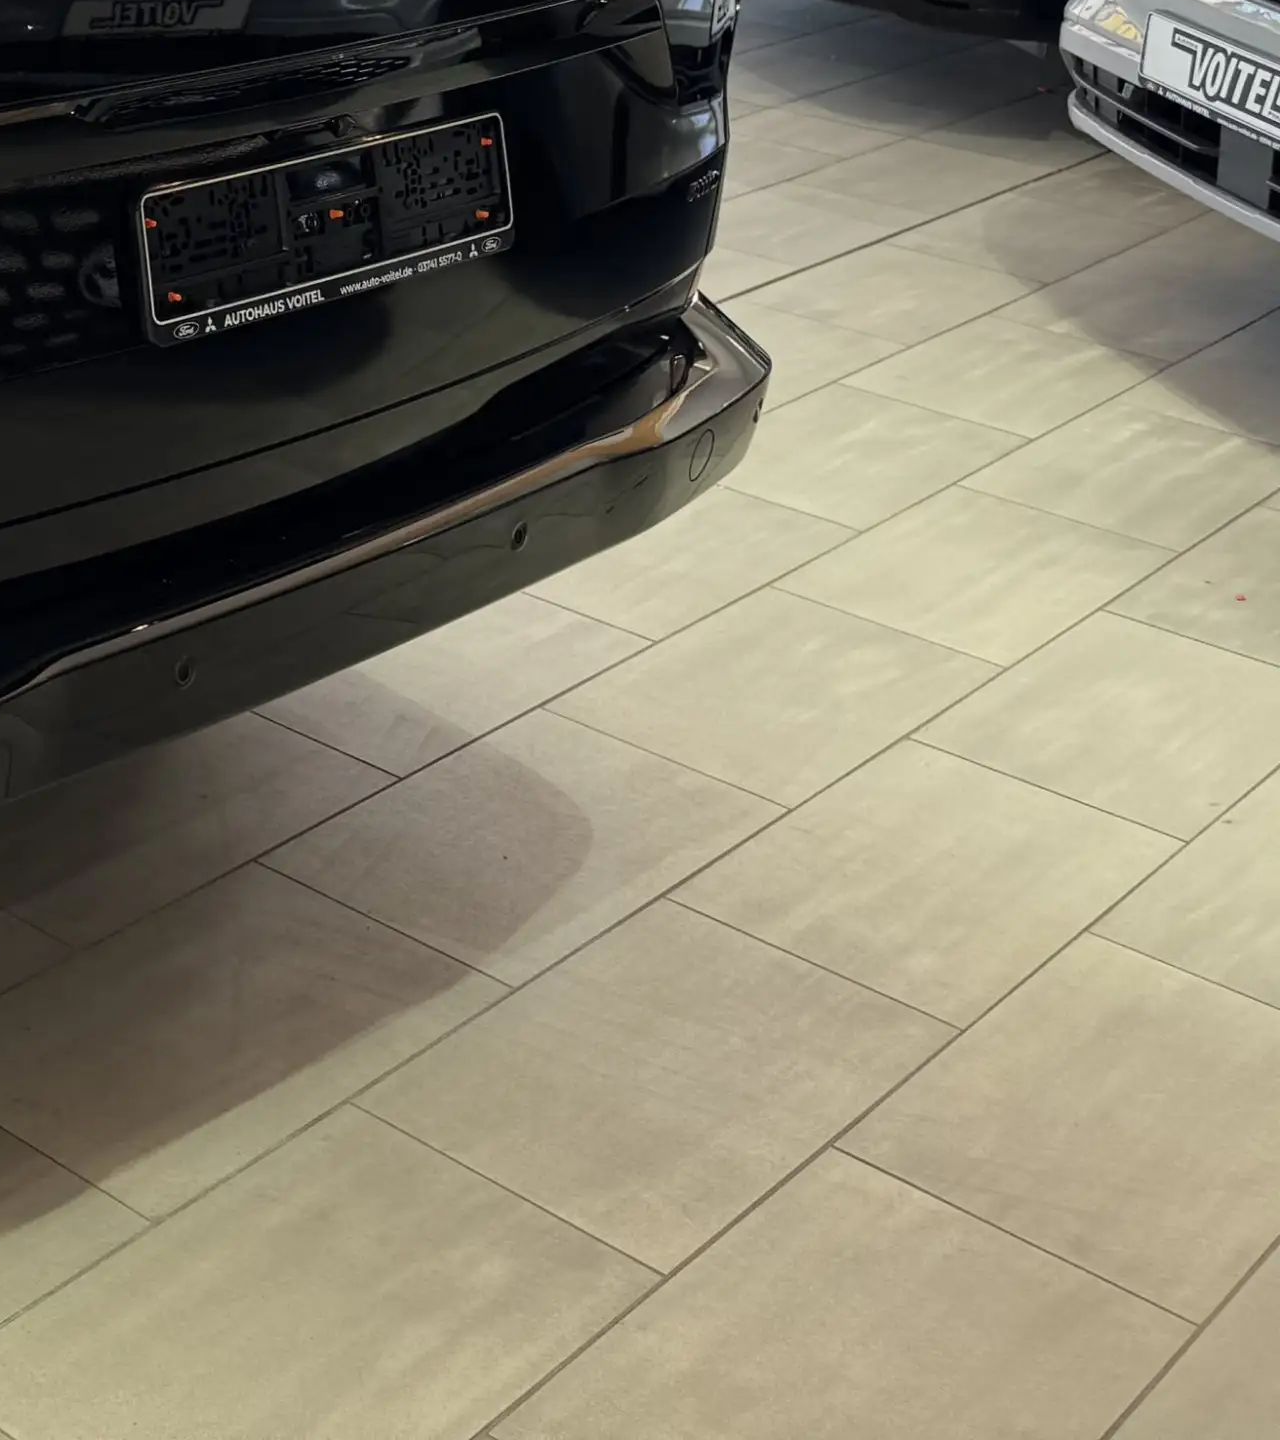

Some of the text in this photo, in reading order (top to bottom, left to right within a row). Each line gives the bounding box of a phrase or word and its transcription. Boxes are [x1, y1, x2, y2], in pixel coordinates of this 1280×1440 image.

[223, 299, 285, 328] AUTOHAUS
[286, 289, 325, 310] VOITEL
[340, 266, 413, 296] www.auto-voitel.de
